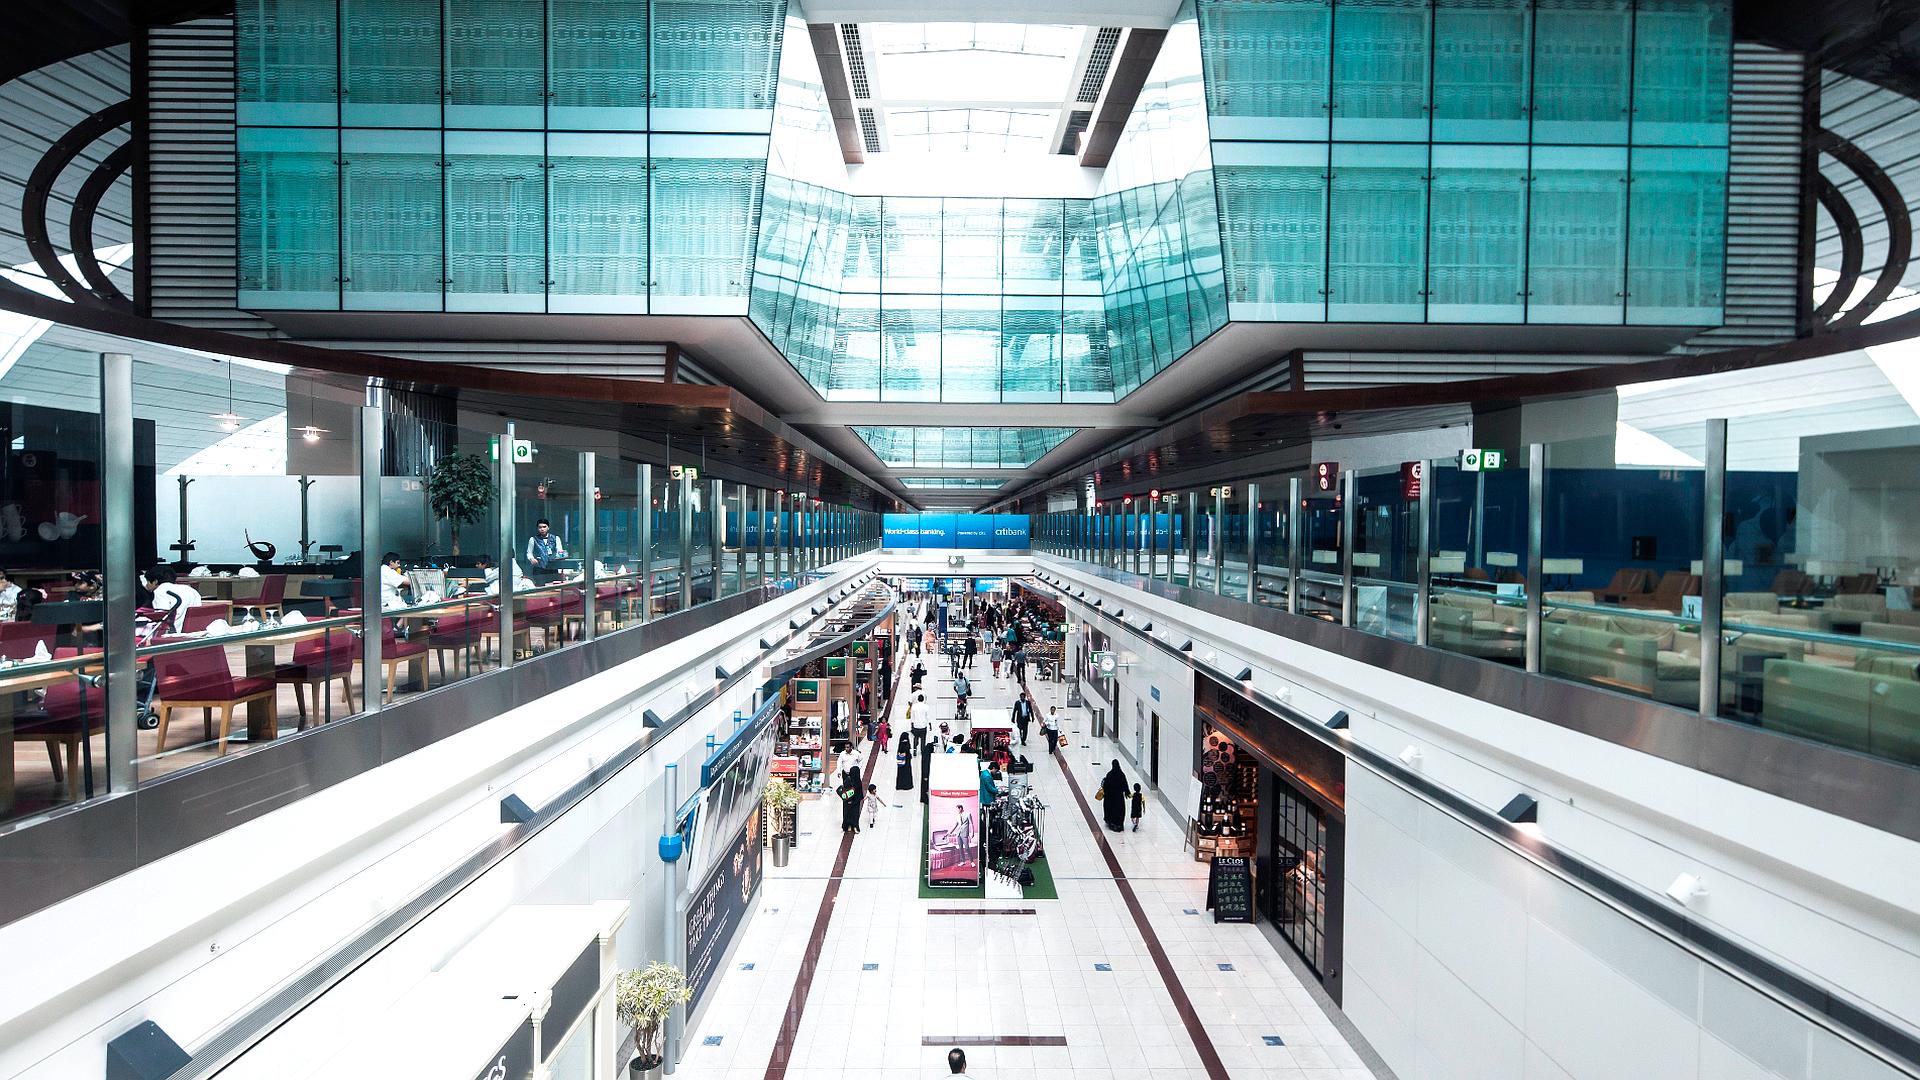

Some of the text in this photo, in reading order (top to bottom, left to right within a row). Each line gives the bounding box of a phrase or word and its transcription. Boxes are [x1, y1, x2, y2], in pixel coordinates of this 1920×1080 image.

[995, 528, 1027, 536] citibank
[688, 898, 707, 936] GREAT
[707, 870, 725, 908] THINGS
